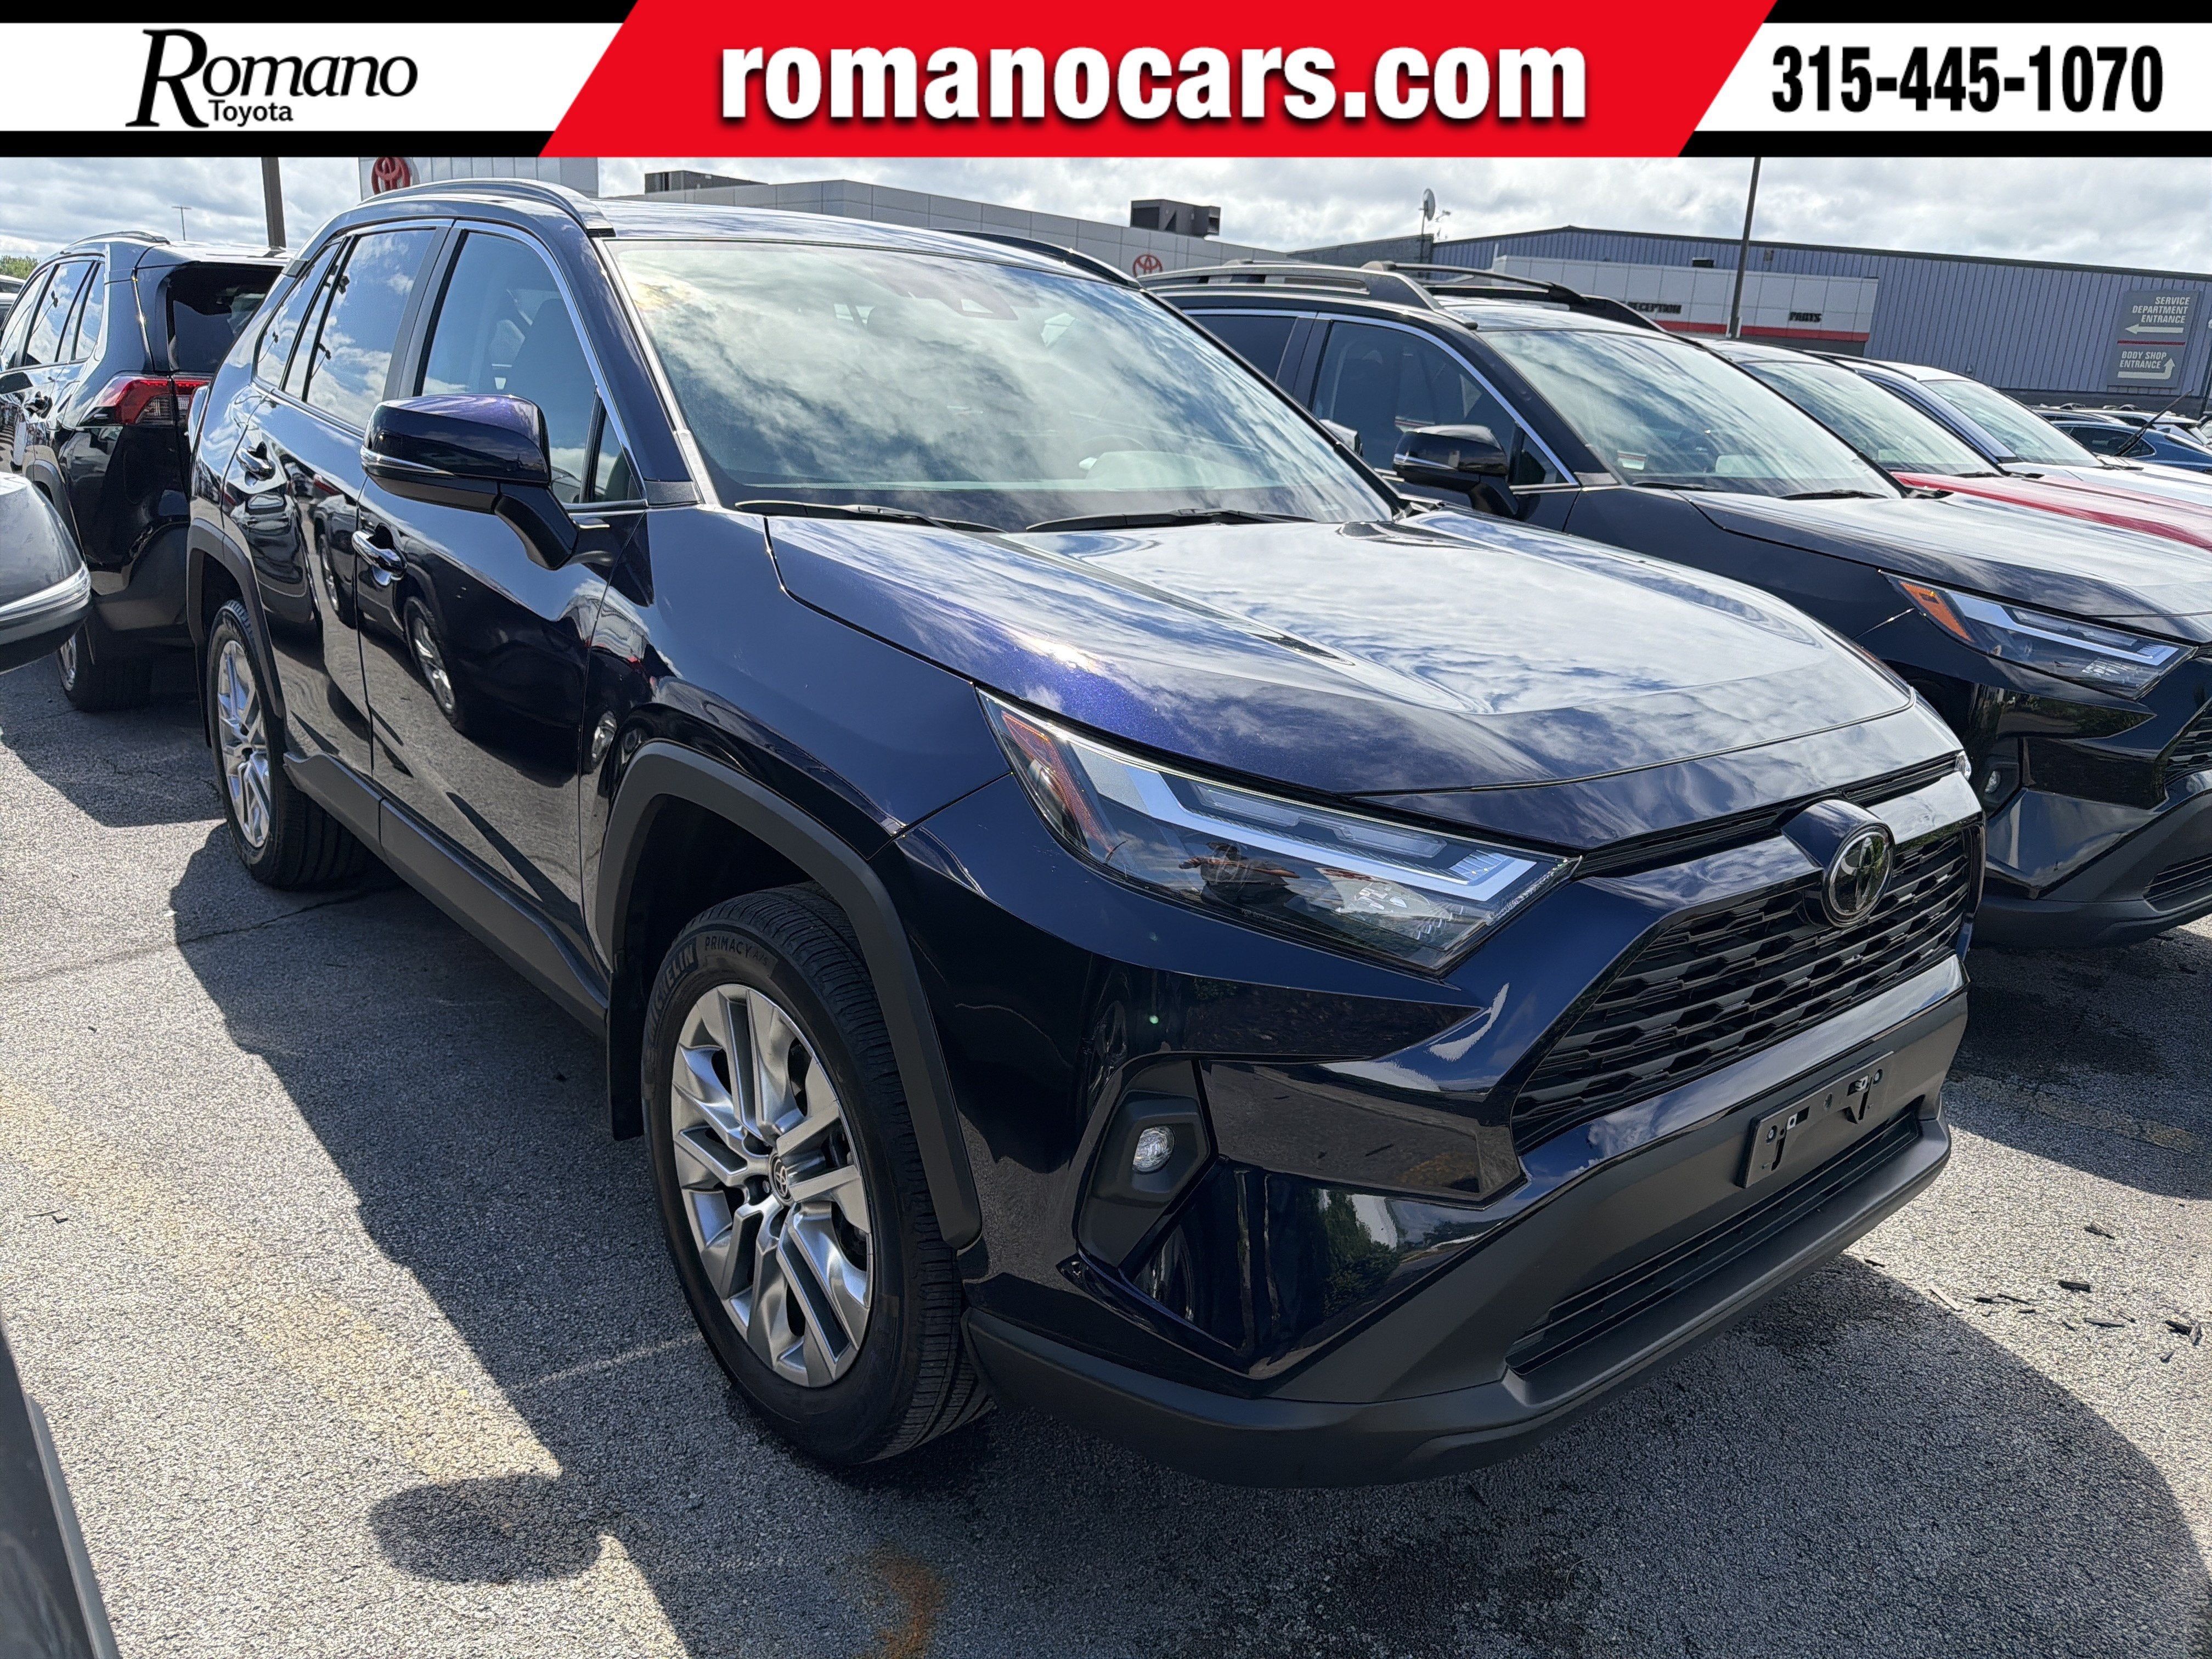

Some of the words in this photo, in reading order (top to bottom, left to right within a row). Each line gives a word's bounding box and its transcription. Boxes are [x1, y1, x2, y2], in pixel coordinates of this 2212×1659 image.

[2155, 297, 2191, 305] SERVICE
[2132, 306, 2188, 314] DEPARTMENT
[2141, 314, 2186, 324] ENTRANCE
[2121, 351, 2143, 359] BODY
[2145, 351, 2167, 360] SHOP
[2119, 360, 2162, 369] ENTRANCE
[705, 935, 753, 958] PRIMACY
